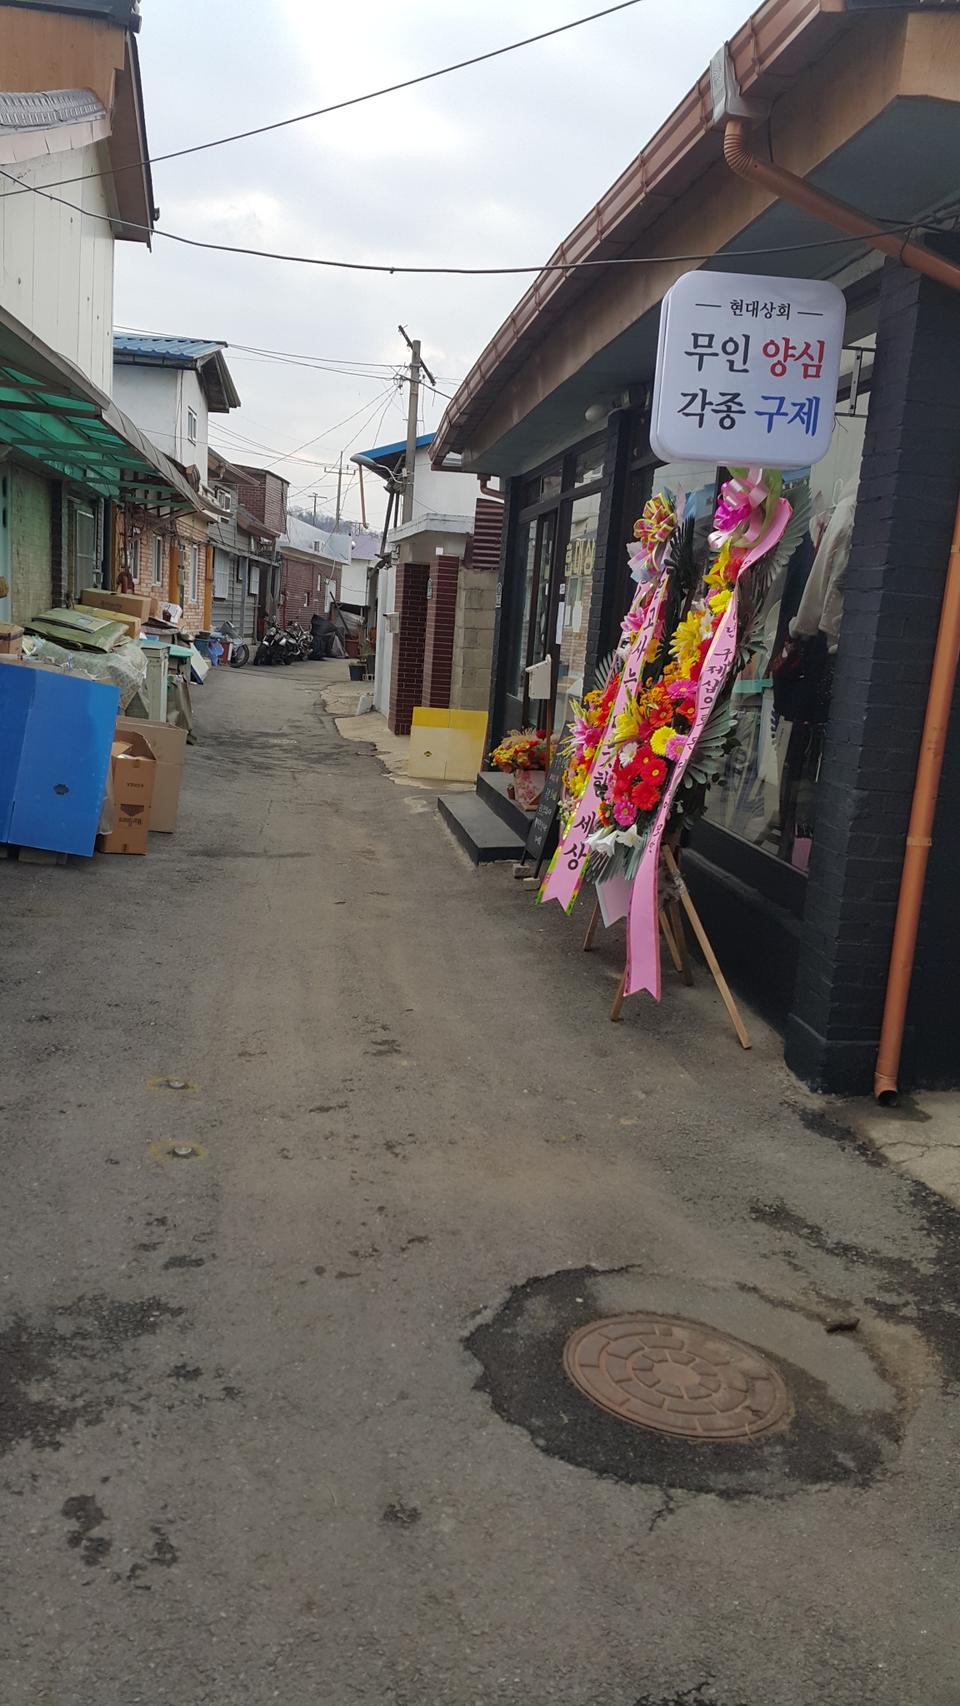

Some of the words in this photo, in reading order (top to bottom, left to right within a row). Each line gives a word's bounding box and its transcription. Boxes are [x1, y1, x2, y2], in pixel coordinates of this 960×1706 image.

[730, 299, 791, 320] 현대상회
[684, 332, 750, 373] 무인
[762, 337, 826, 379] 양심
[677, 388, 746, 430] 각종
[755, 395, 821, 437] 구제
[563, 811, 597, 871] 세상
